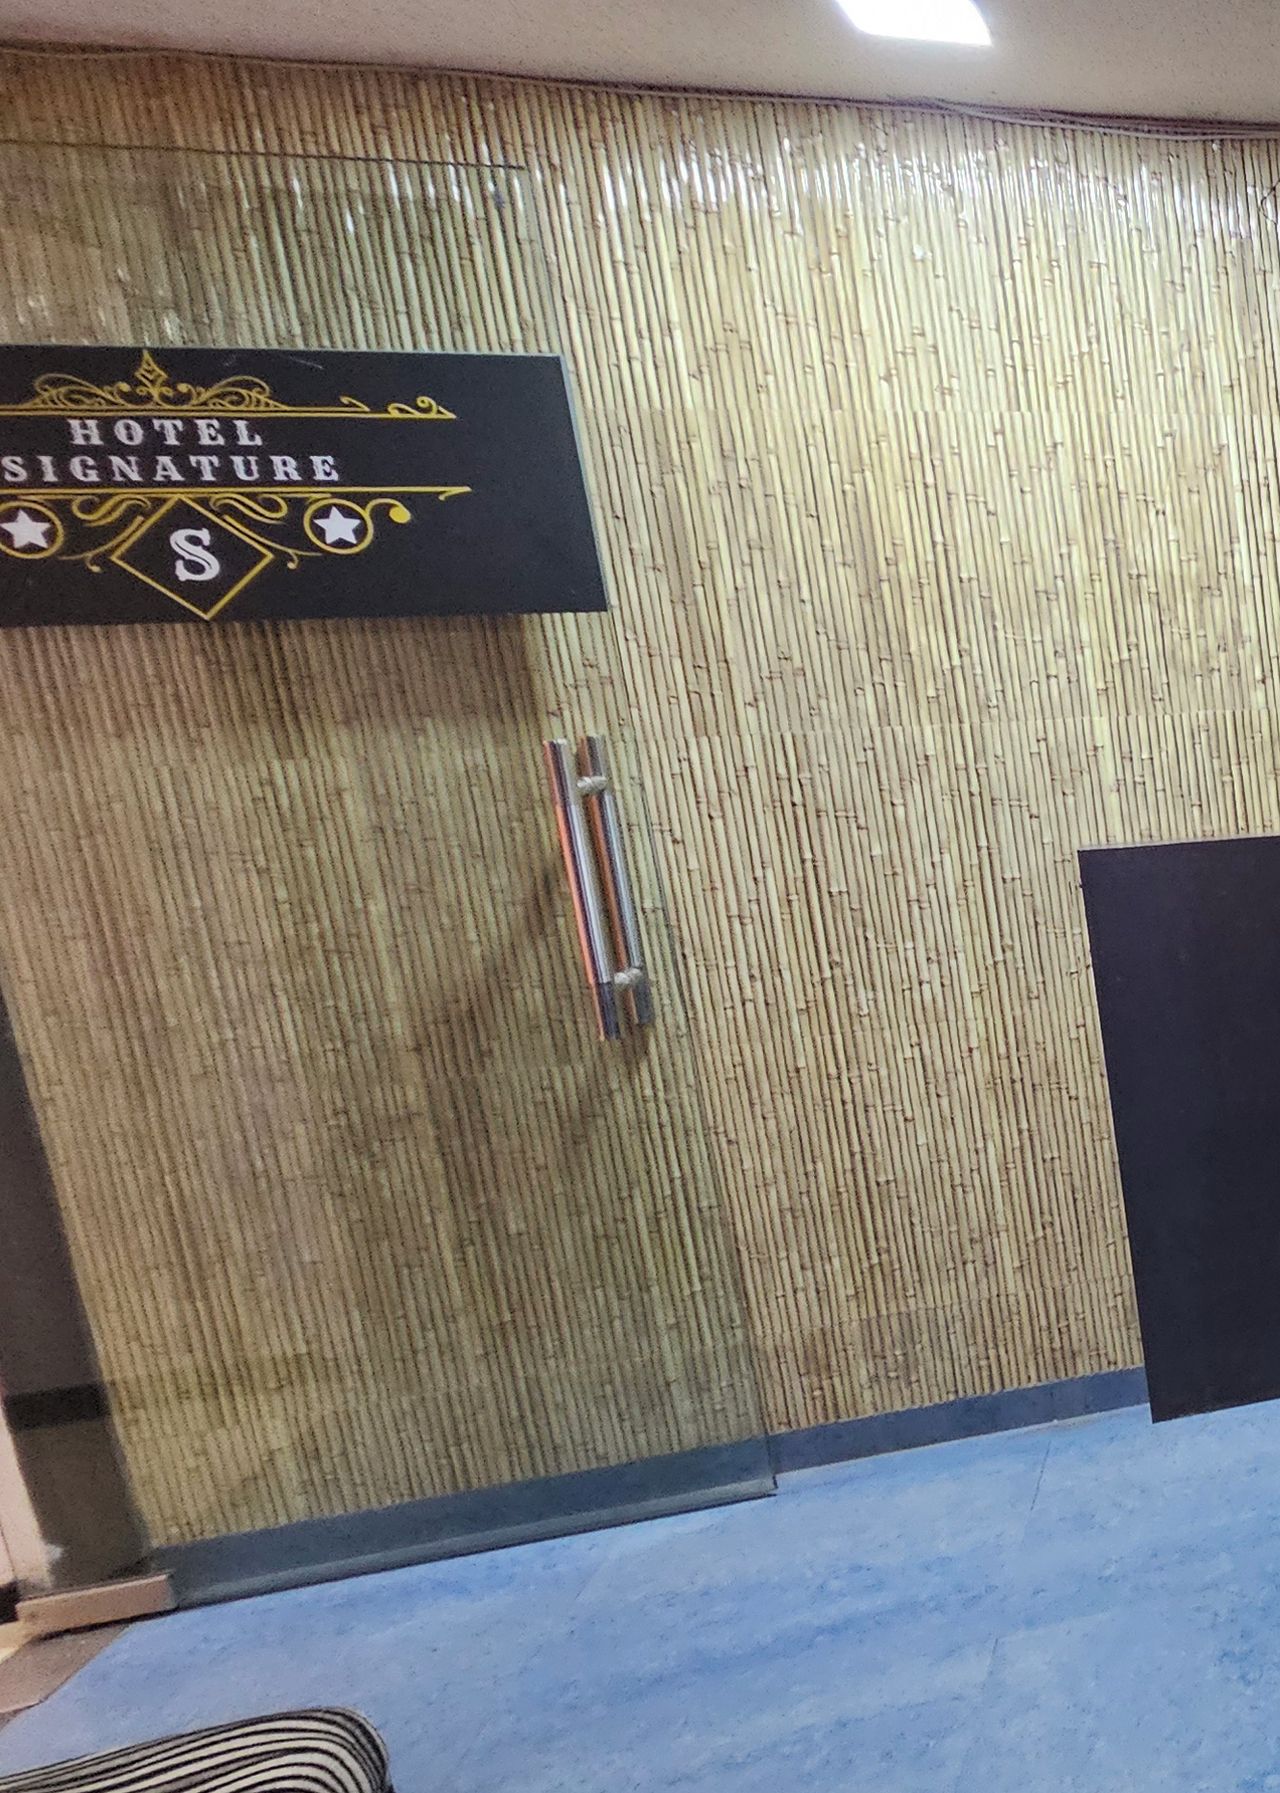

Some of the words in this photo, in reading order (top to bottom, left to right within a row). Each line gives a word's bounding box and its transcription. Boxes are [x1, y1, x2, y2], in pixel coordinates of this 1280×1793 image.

[68, 419, 264, 446] HOTEL
[2, 454, 341, 482] SIGNATURE
[169, 528, 221, 581] S
